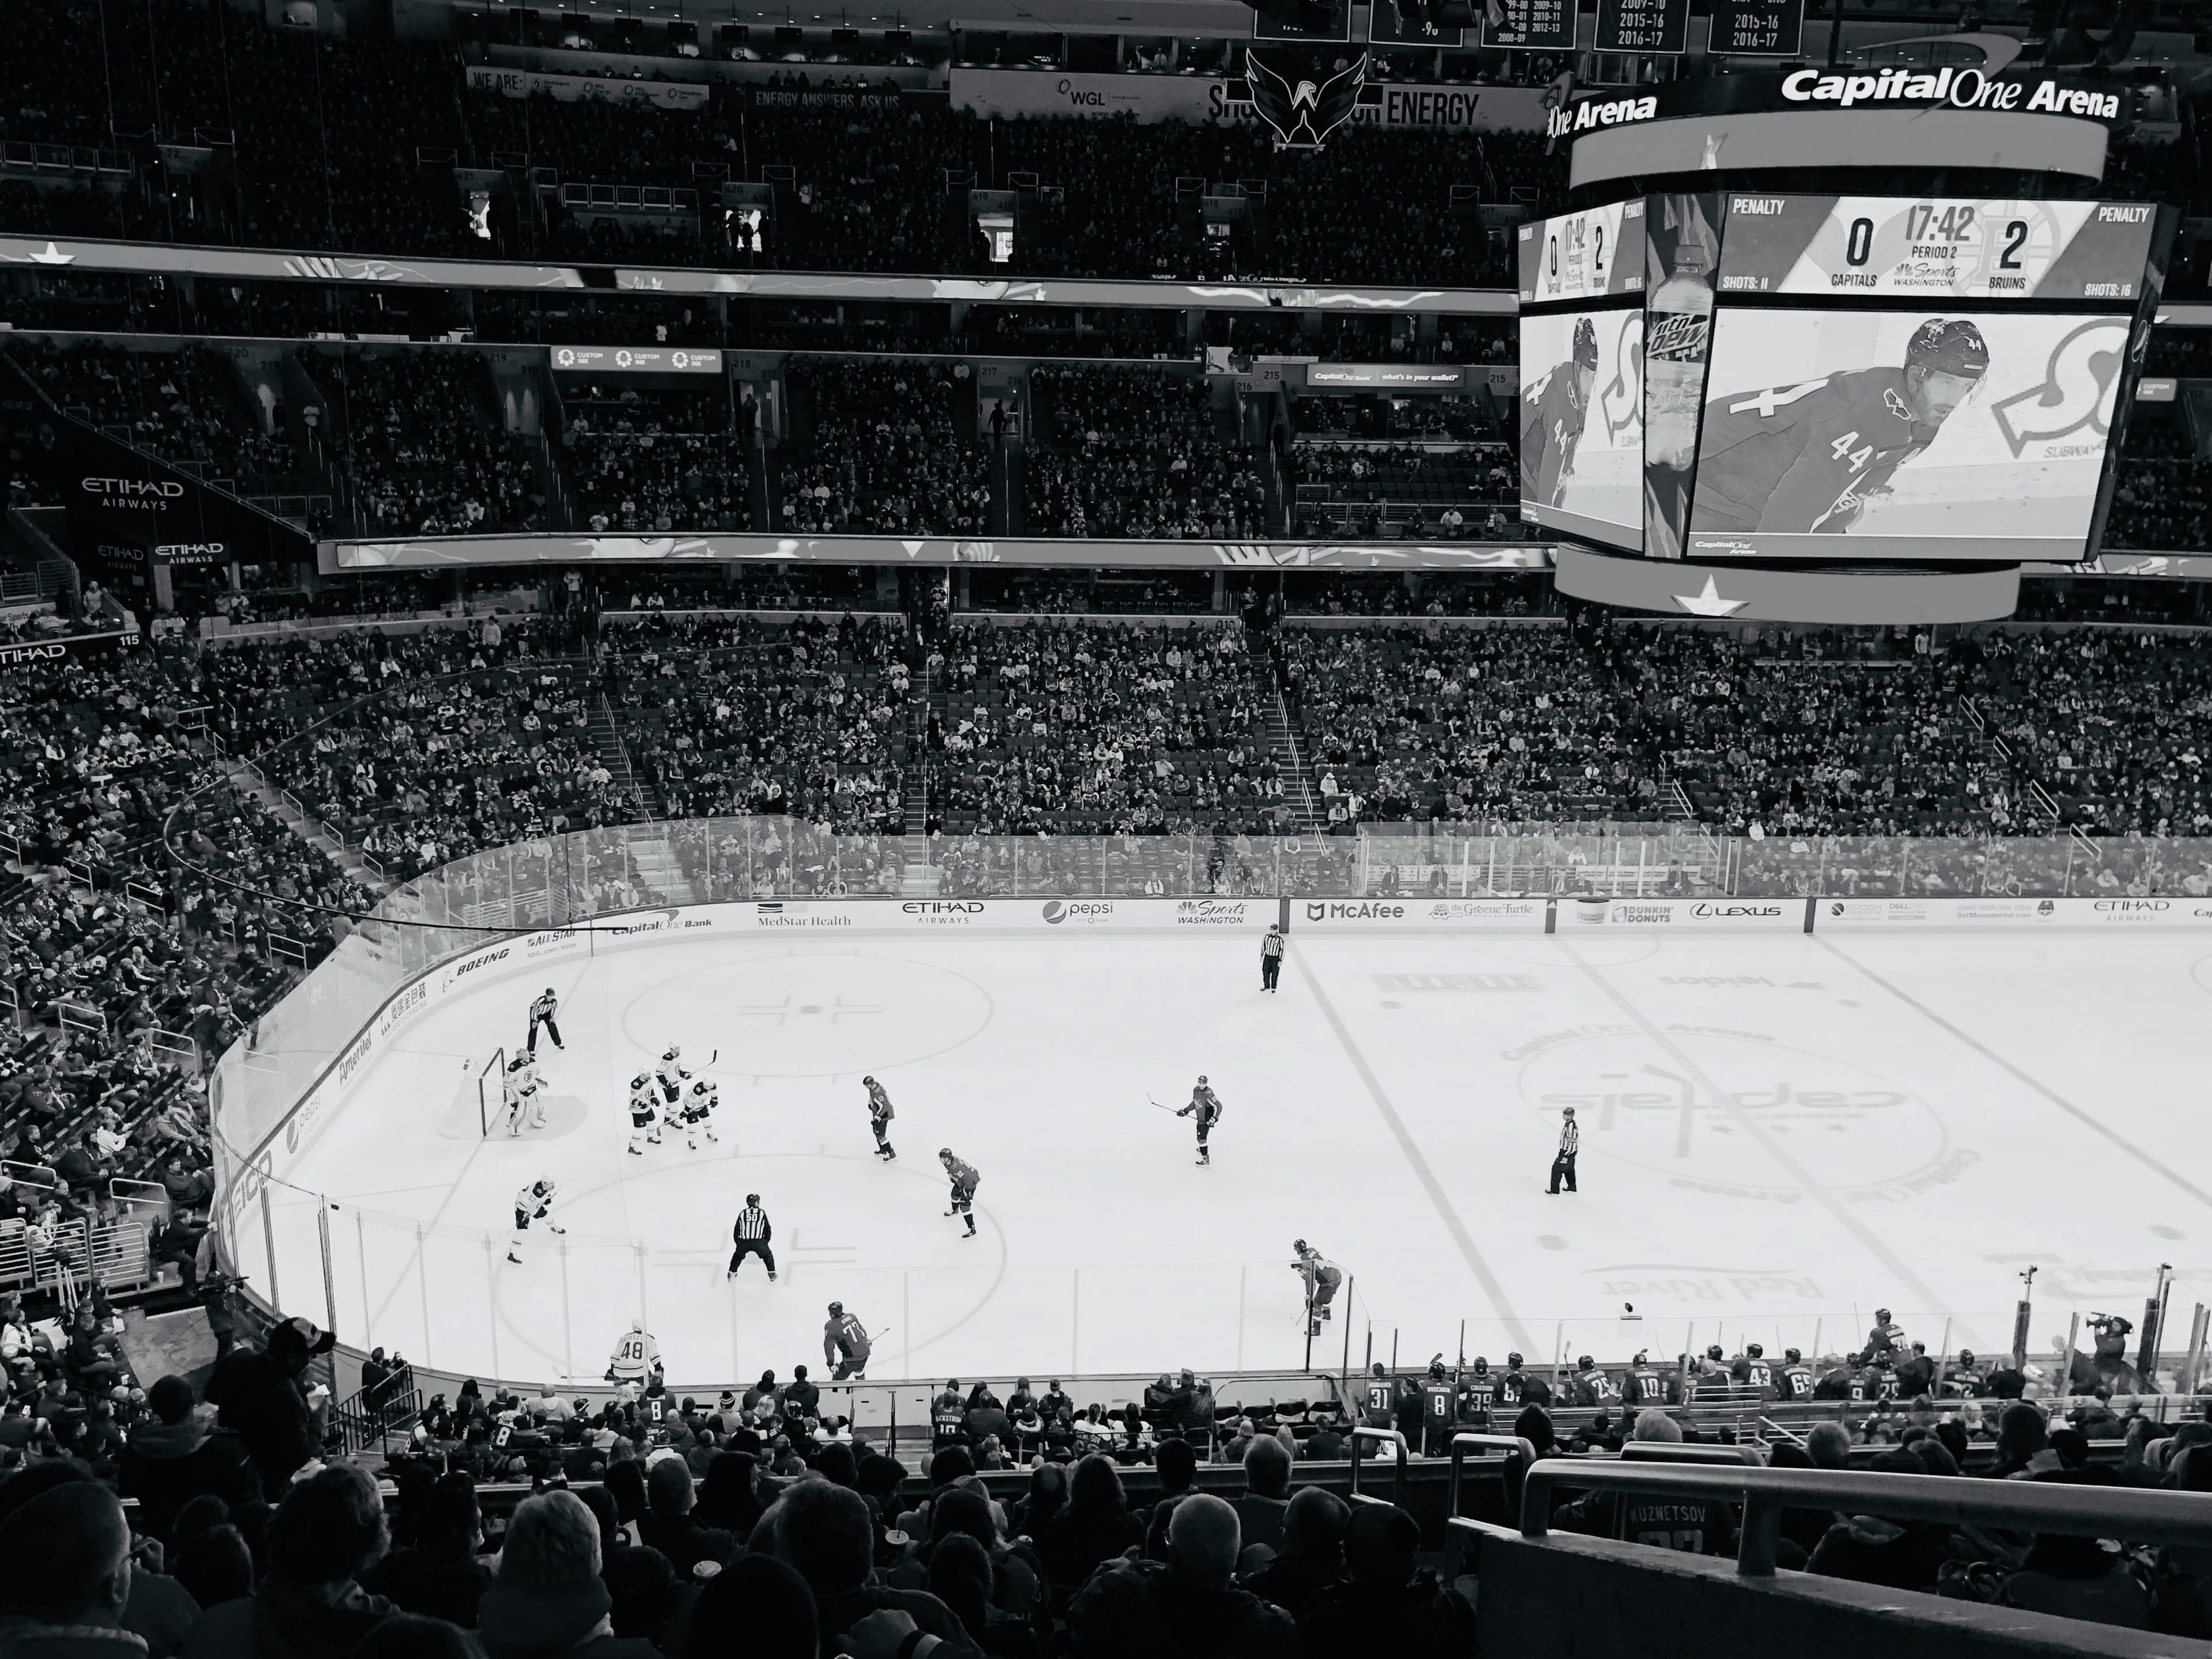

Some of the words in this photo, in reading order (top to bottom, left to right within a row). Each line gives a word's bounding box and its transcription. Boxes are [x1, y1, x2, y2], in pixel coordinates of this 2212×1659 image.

[1532, 12, 1561, 21] 2010-11
[1620, 13, 1664, 28] 2015-16
[1735, 14, 1779, 29] 2015-16
[1532, 23, 1560, 32] 2012-13
[1498, 33, 1526, 43] 2008-09
[1618, 31, 1664, 46] 2016-17
[1732, 32, 1778, 47] 2016-17
[474, 72, 492, 88] WE
[495, 73, 523, 90] ARE:
[755, 91, 798, 108] ENERGY
[860, 93, 883, 110] ASK
[884, 94, 900, 110] US
[1070, 90, 1105, 106] WGL
[2027, 81, 2119, 118] Arena
[1388, 91, 1480, 126] ENERGY
[1574, 96, 1657, 130] Arena
[972, 193, 988, 202] 419
[1732, 198, 1785, 215] PENALTY
[2097, 207, 2150, 223] PENALTY
[1906, 205, 1975, 241] 17:42
[1566, 217, 1585, 252] 17:42
[1846, 218, 1873, 266] 0
[1596, 226, 1603, 270] 2
[1911, 246, 1949, 258] PERIOD
[1951, 247, 1958, 259] 2
[1999, 221, 2028, 269] 2
[1551, 235, 1558, 276] 0
[1914, 263, 1961, 278] Sports
[1722, 276, 1758, 289] SHOTS:
[1831, 274, 1877, 286] CAPITALS
[1893, 278, 1954, 287] WASHINGTON
[1988, 276, 2026, 289] BRUINS
[2084, 284, 2120, 296] SHOTS:
[2122, 285, 2131, 297] 16
[1968, 338, 1983, 351] 44
[732, 359, 751, 369] 218
[981, 368, 997, 376] 217
[1263, 371, 1280, 381] 215
[1490, 374, 1506, 384] 215
[1238, 382, 1252, 391] 216
[1830, 431, 1874, 474] 44
[82, 477, 184, 497] ETIHAD
[103, 498, 167, 511] AIRWAYS
[98, 545, 144, 560] ETIHAD
[156, 543, 224, 555] ETIHAD
[169, 555, 213, 564] AIRWAYS
[120, 635, 139, 646] 115
[902, 902, 984, 914] ETIHAD
[1070, 901, 1113, 916] pepsi
[1198, 900, 1249, 917] Sports
[1331, 903, 1405, 918] McAfee
[1464, 903, 1503, 917] Greene
[1502, 903, 1534, 914] Turtle
[1628, 906, 1673, 915] DUNKIN'
[1715, 907, 1782, 916] LEXUS
[2094, 900, 2170, 911] ETIHAD
[684, 919, 713, 928] Bank
[758, 916, 808, 926] MedStar
[812, 916, 851, 926] Health
[1628, 914, 1671, 923] DONUTS
[2106, 914, 2154, 922] AIRWAYS
[457, 948, 510, 977] BOEING
[1658, 976, 1776, 988] leidos
[1664, 1022, 1777, 1042] Arena
[299, 1090, 322, 1134] pepsi
[1669, 1178, 1802, 1205] Arena
[1603, 1279, 1726, 1302] River
[1727, 1275, 1830, 1301] Red
[842, 1320, 866, 1344] 77
[620, 1342, 643, 1360] 48
[1749, 1367, 1771, 1387] 43
[1640, 1377, 1660, 1399] 10
[1370, 1387, 1388, 1410] 31
[1434, 1395, 1445, 1416] 8
[1471, 1393, 1493, 1412] 39
[651, 1400, 662, 1421] 8
[495, 1426, 511, 1447] 8
[1630, 1505, 1706, 1524] KUZNETSOV
